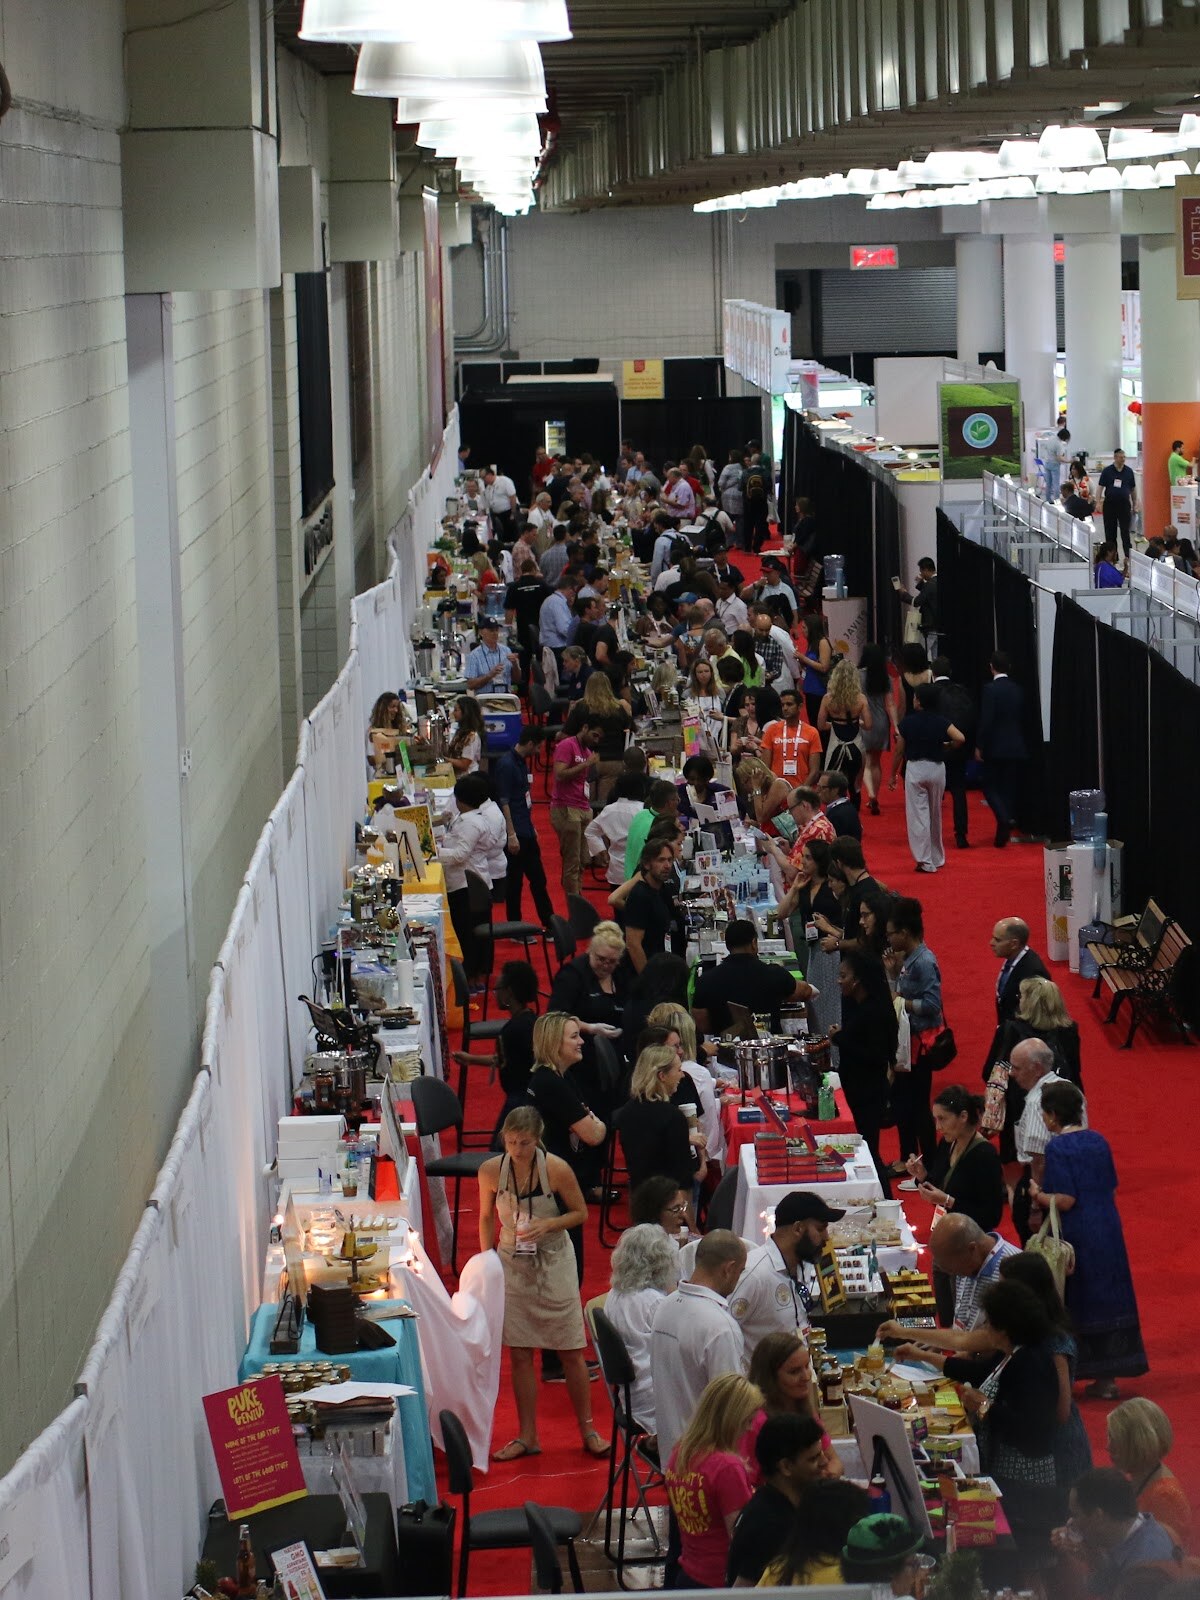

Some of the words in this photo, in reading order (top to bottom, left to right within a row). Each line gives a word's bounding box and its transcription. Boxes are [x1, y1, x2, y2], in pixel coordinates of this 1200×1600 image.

[227, 1386, 260, 1418] PURE
[234, 1402, 265, 1426] GENIUS
[290, 1549, 305, 1560] GMO
